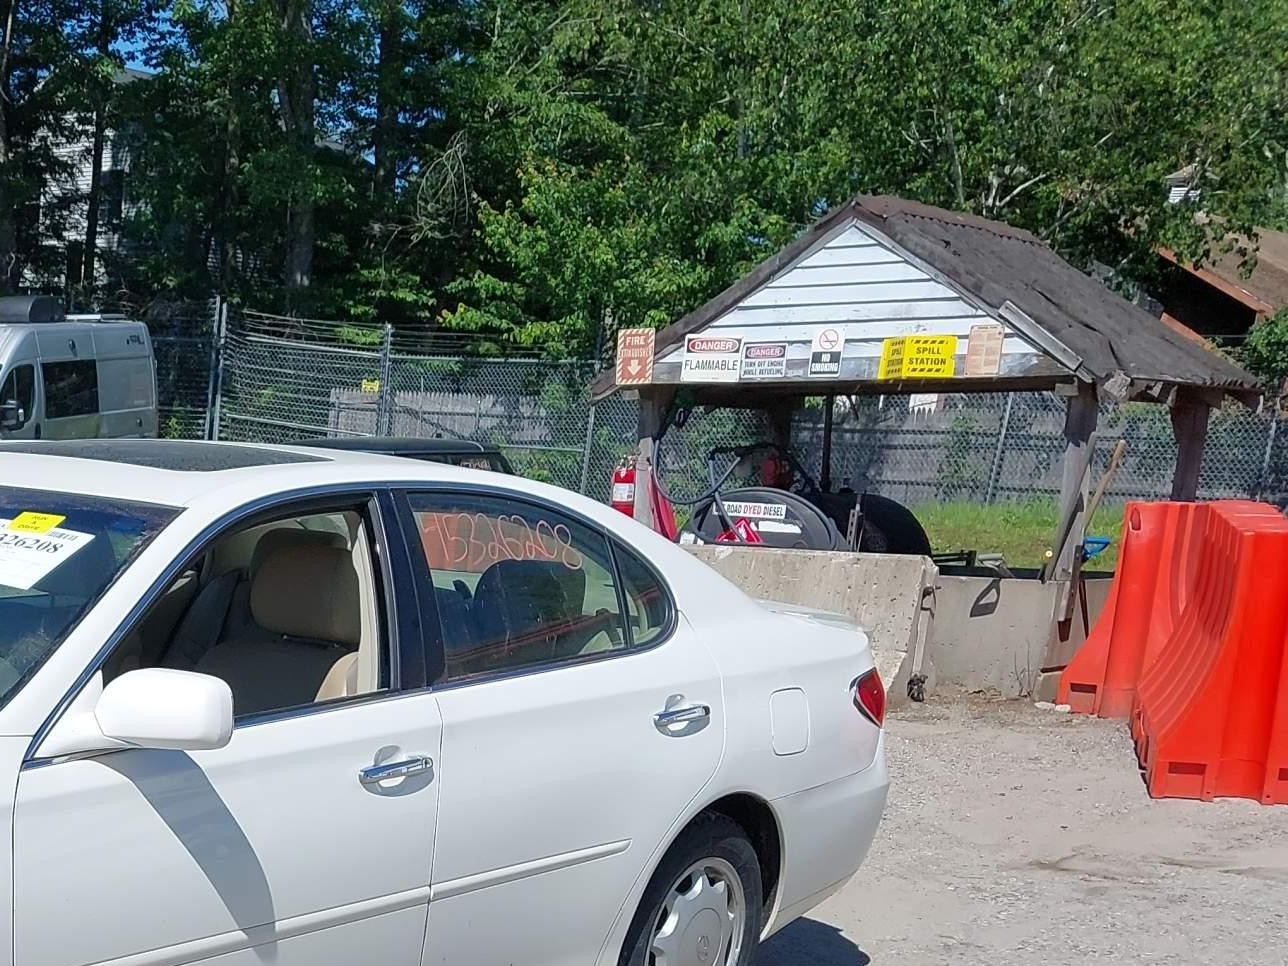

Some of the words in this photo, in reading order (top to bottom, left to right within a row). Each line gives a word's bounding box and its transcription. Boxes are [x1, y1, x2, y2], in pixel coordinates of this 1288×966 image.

[625, 335, 646, 346] FIRE
[694, 340, 733, 351] DANGER
[750, 347, 781, 357] DANGER
[915, 346, 942, 355] SPILL
[821, 353, 831, 363] NO
[908, 357, 947, 366] STATION
[684, 359, 738, 371] FLAMMABLE
[811, 362, 838, 372] SMOKING
[726, 503, 743, 514] ROAD
[743, 504, 762, 515] DYED
[763, 505, 784, 517] DIESEL
